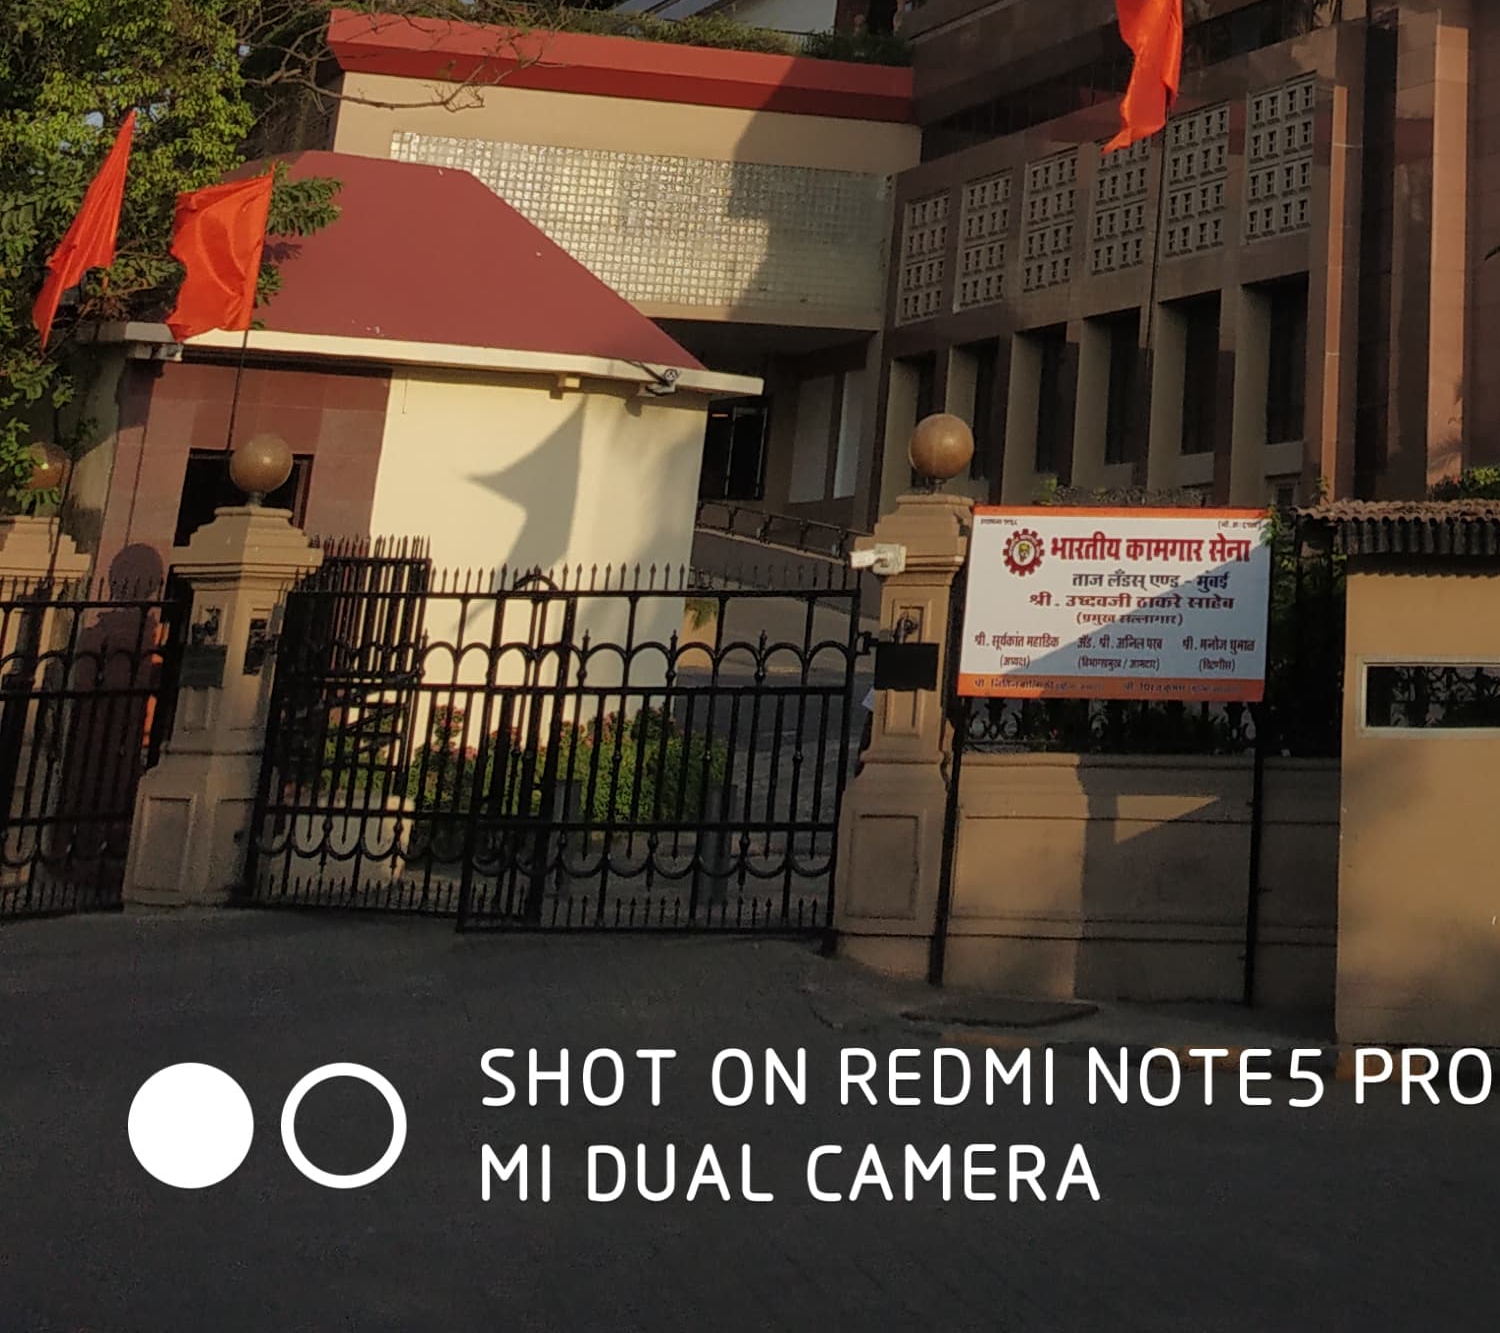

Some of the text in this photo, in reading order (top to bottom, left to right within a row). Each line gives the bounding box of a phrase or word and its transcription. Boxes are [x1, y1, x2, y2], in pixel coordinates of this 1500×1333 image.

[1051, 531, 1122, 561] भारतीय
[1126, 538, 1204, 562] कामगार
[1209, 532, 1251, 563] सेना
[1072, 573, 1104, 588] ताज
[1196, 570, 1231, 593] मुंबई
[1136, 593, 1183, 609] ठाकरे
[1187, 594, 1236, 610] साहेब
[1116, 634, 1145, 650] अनिल
[1199, 636, 1227, 651] मनोज
